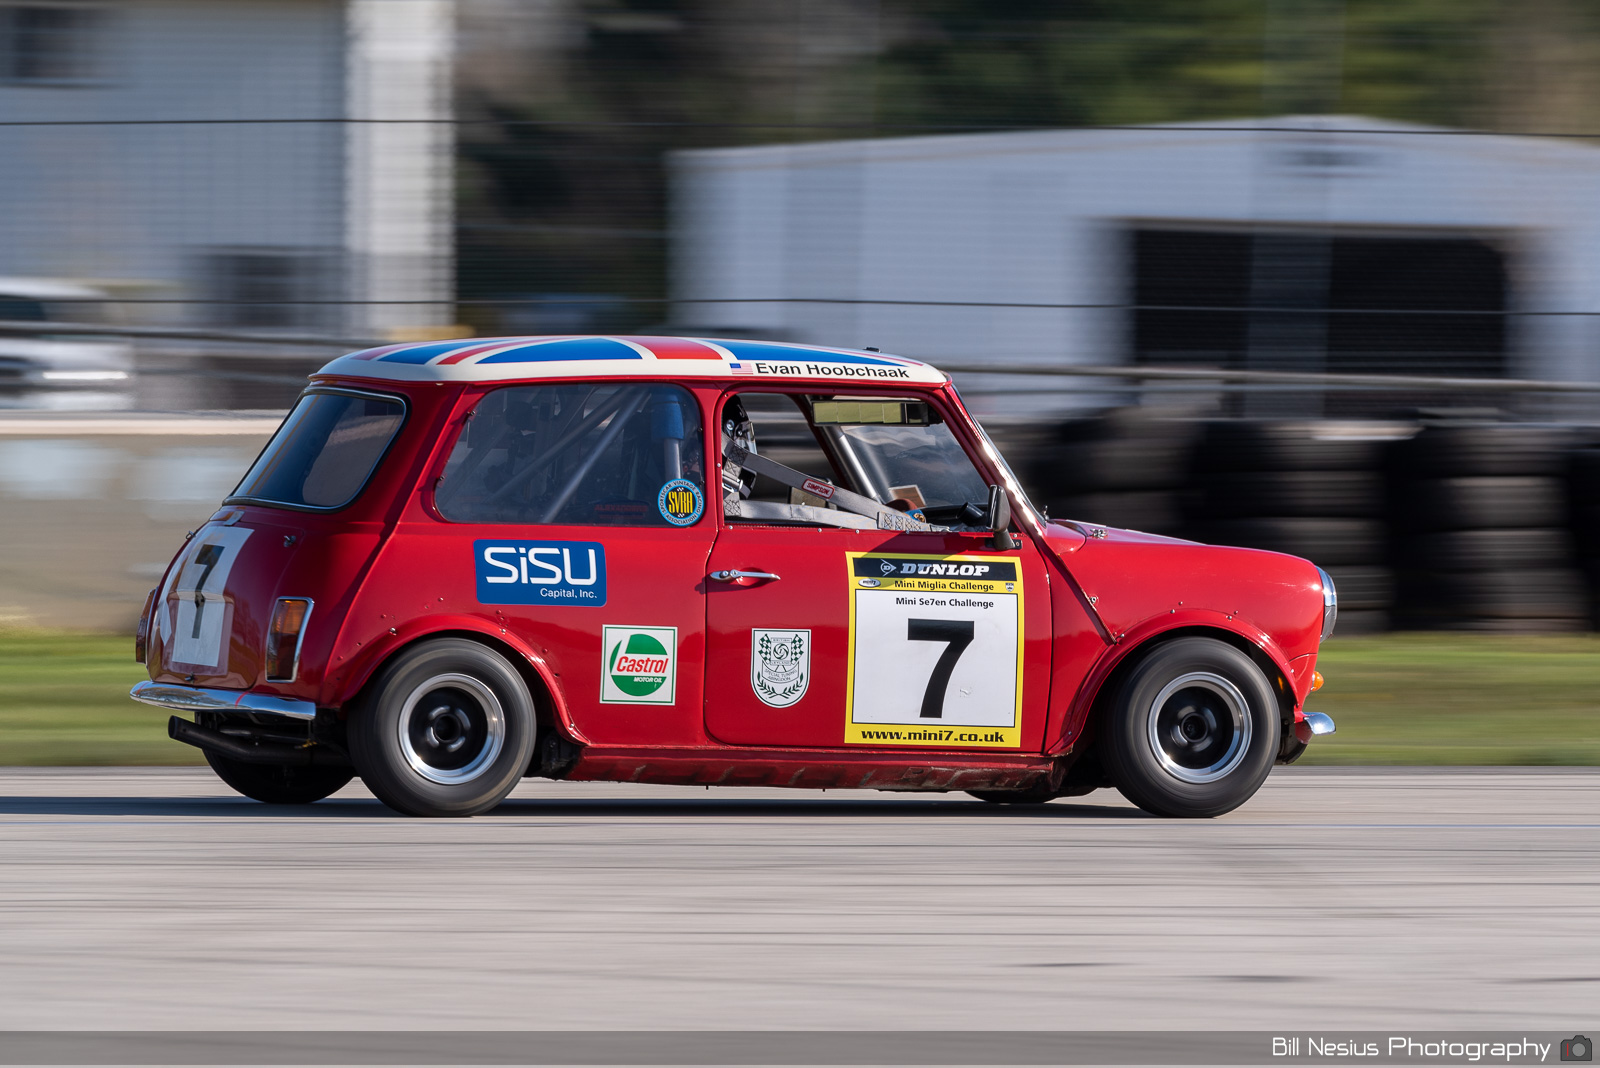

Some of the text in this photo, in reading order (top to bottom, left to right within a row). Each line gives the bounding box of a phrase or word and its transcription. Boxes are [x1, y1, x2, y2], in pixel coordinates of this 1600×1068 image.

[755, 363, 910, 378] Evan Hoobchaak
[806, 482, 830, 495] SIMPSON
[668, 491, 694, 514] SVRA
[484, 547, 597, 586] SiSU
[900, 562, 990, 577] DUNLOP
[191, 544, 225, 639] 7
[540, 588, 598, 599] Capital, Inc.
[894, 581, 994, 592] Mini Miglia Challenge
[895, 597, 994, 609] Mini Se7en Challenge
[616, 656, 669, 674] Castrol
[908, 618, 975, 719] 7
[861, 730, 1004, 743] www.mini7.co.uk
